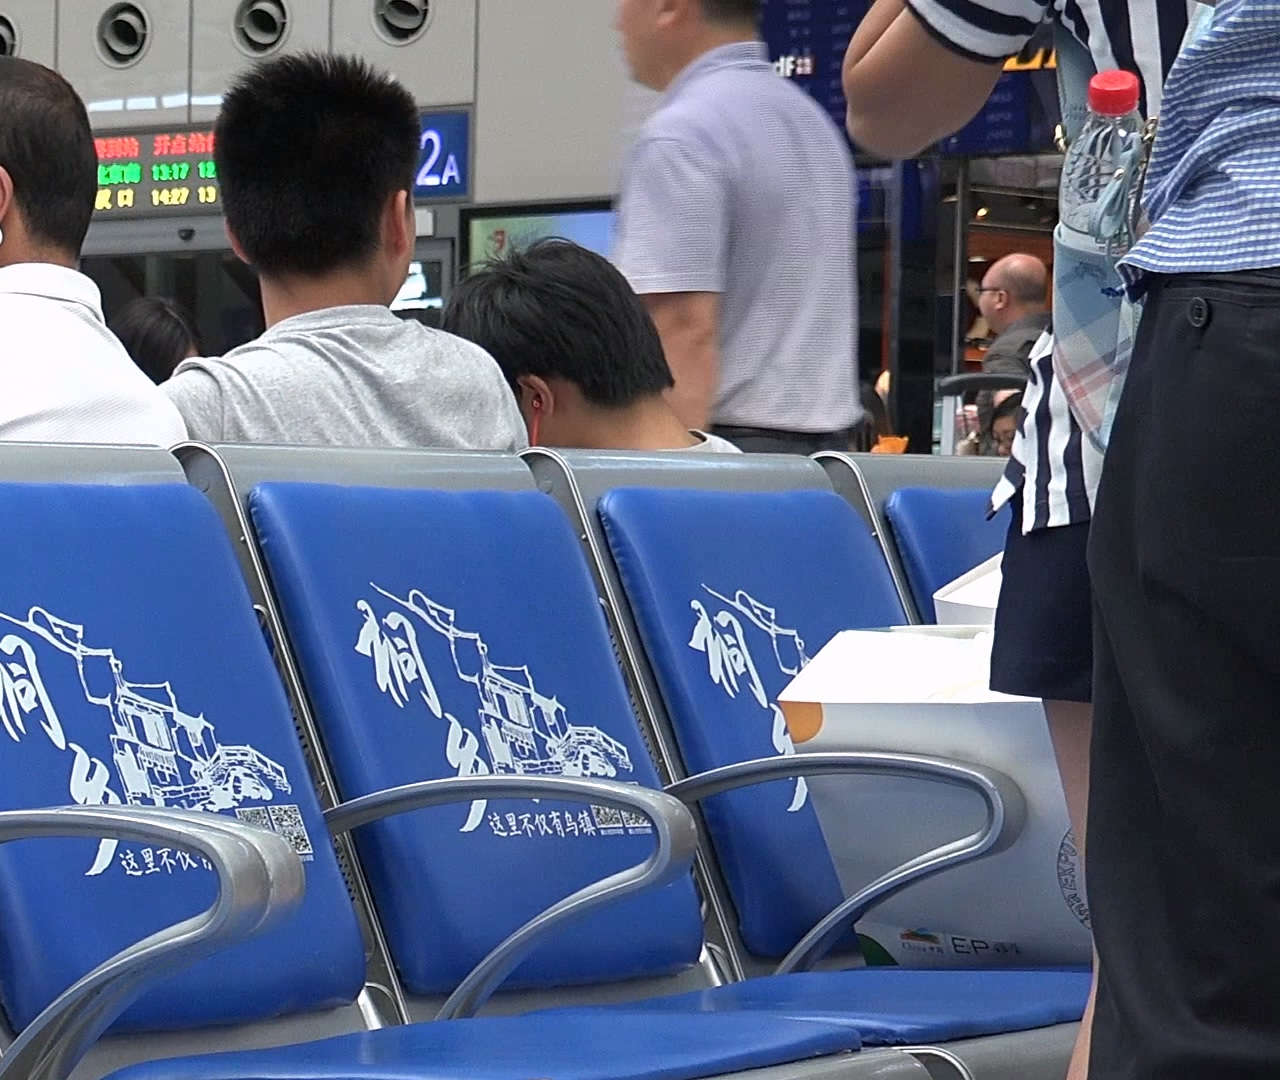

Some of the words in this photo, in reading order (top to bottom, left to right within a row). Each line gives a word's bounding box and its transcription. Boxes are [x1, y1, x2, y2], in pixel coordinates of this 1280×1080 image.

[416, 129, 460, 186] 2A
[151, 162, 190, 180] 13:17
[152, 187, 190, 205] 14:27
[488, 809, 596, 838] 这里不仅有乌镇
